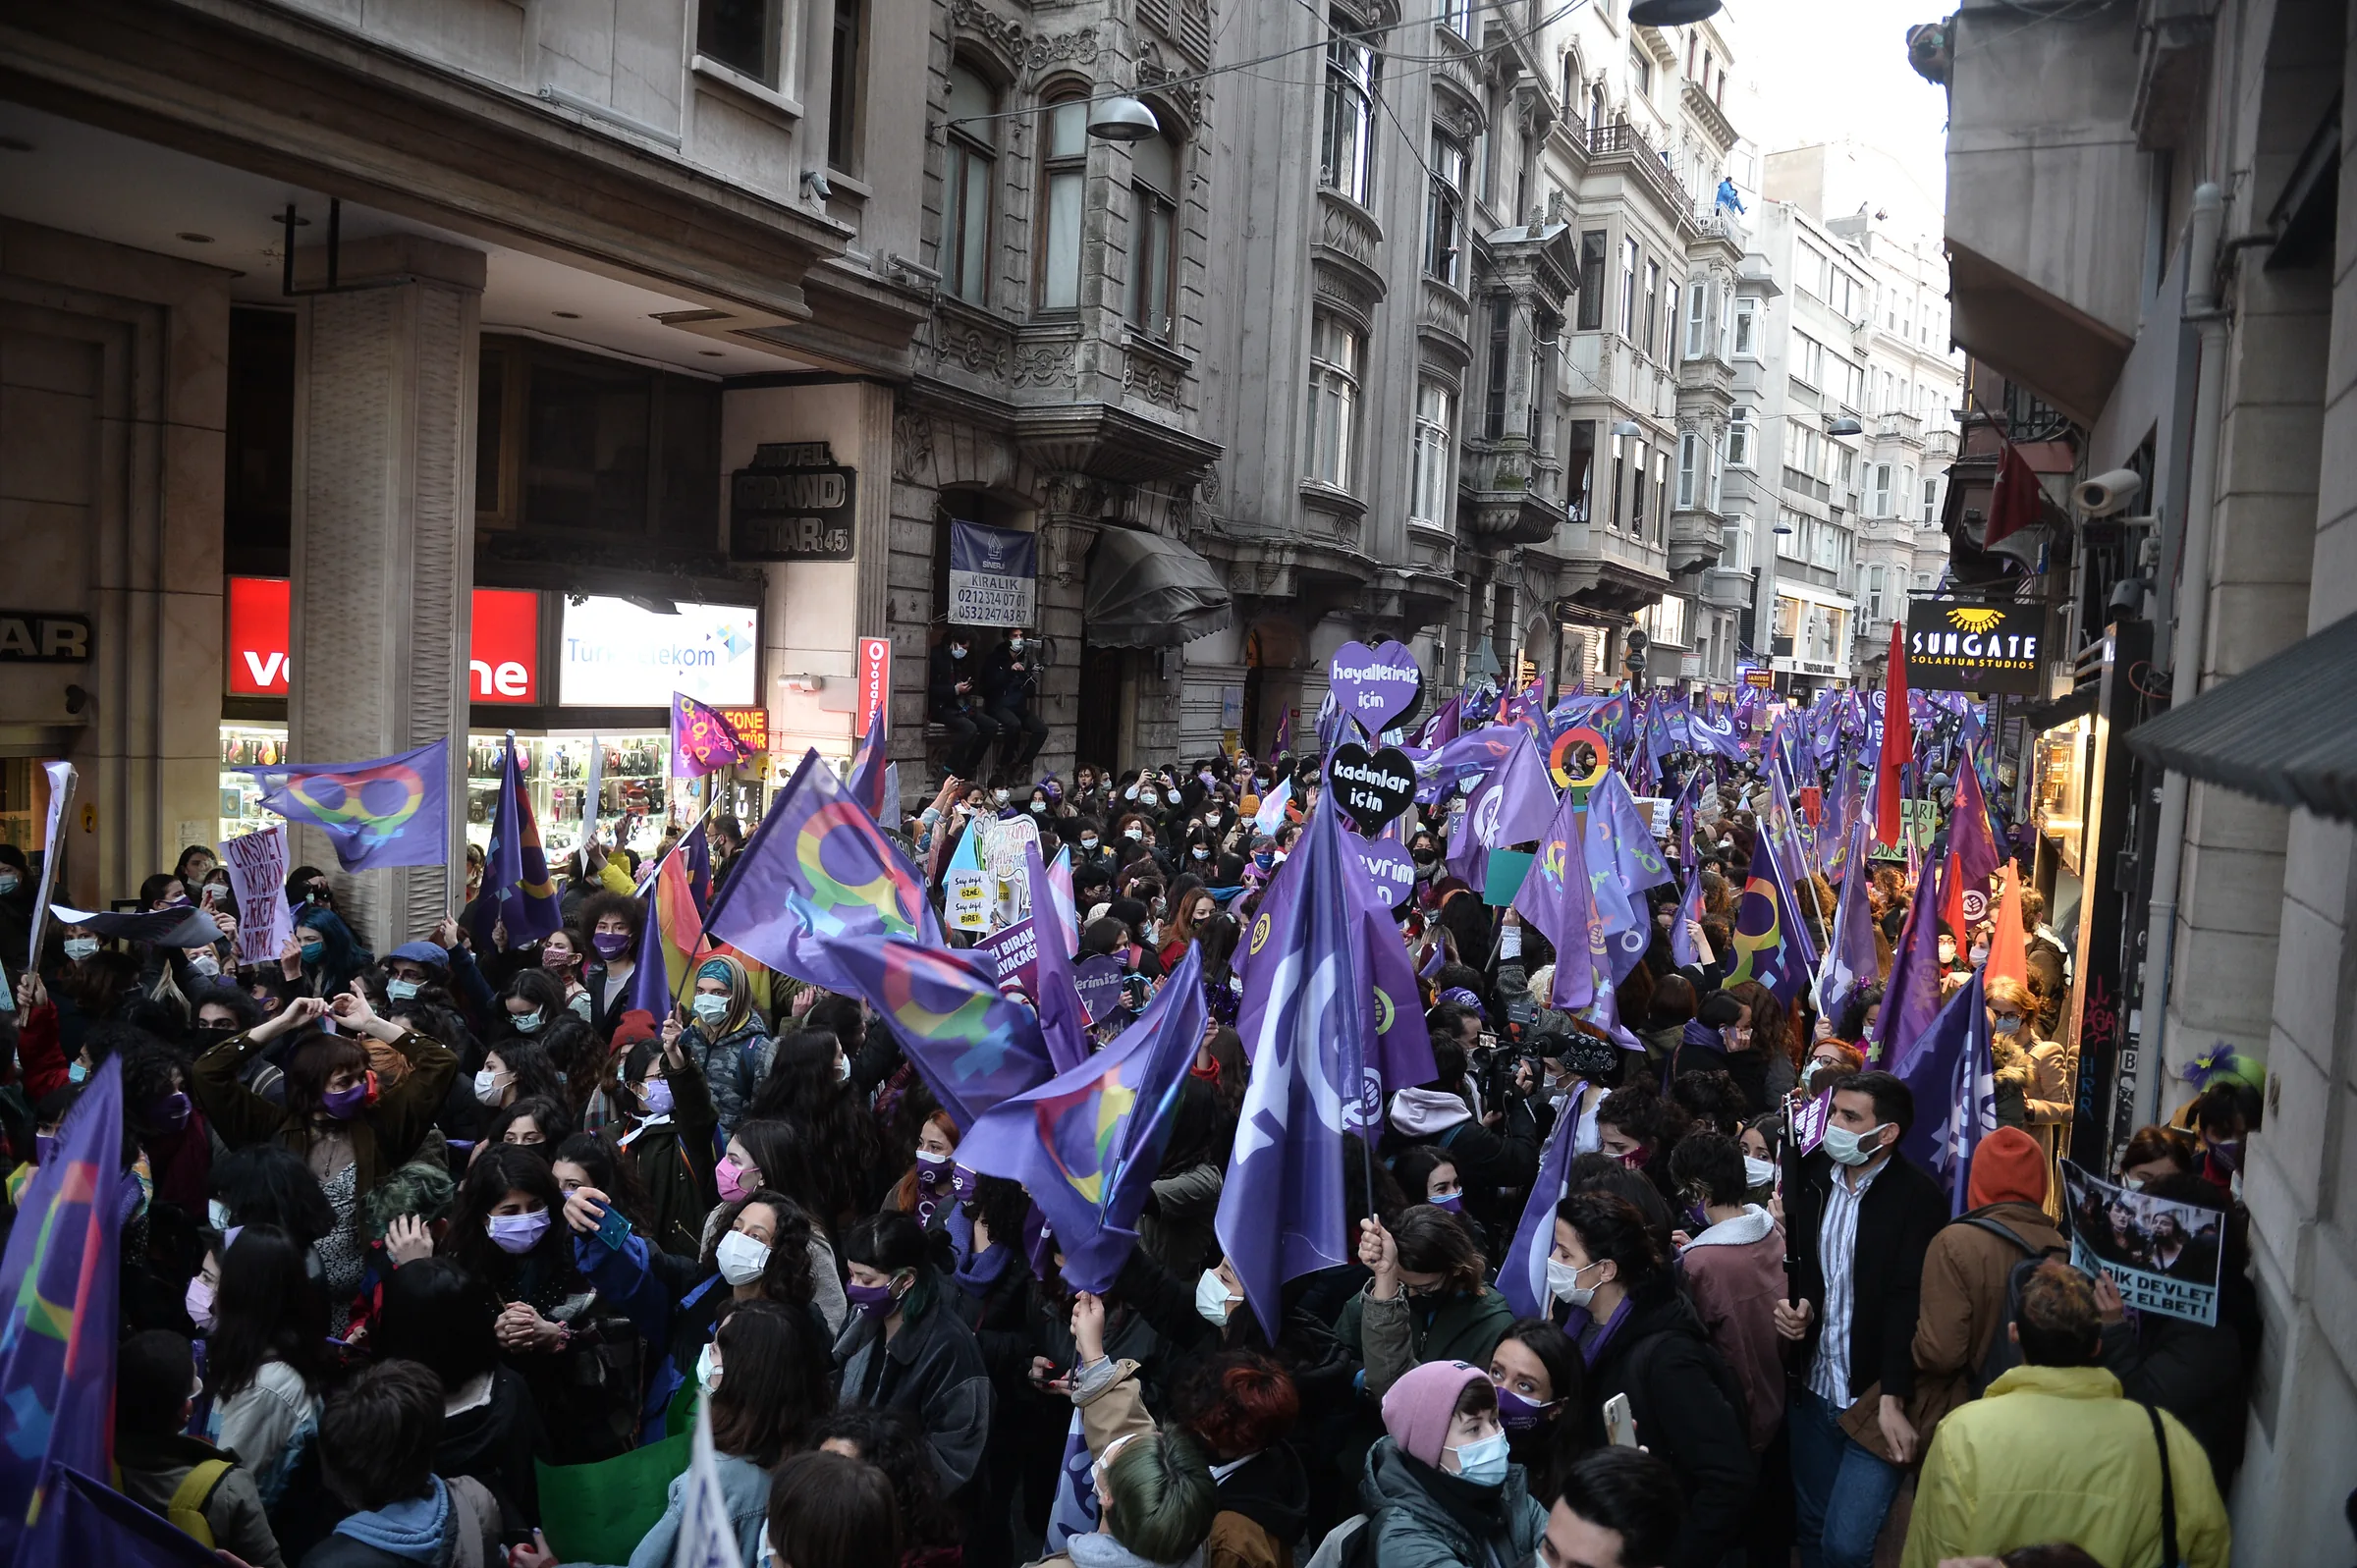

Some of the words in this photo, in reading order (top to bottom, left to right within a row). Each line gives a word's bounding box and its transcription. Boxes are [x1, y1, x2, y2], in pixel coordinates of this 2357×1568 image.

[736, 473, 846, 509] GRAND
[747, 517, 824, 552] STAR
[971, 574, 1018, 590] KİRALIK
[959, 589, 983, 604] 0212
[985, 591, 1002, 605] 324
[1004, 592, 1015, 606] 07
[959, 605, 983, 620] 0532
[985, 607, 1002, 621] 247
[1004, 609, 1014, 622] 43
[1912, 631, 2037, 659] SUNGATE
[1333, 660, 1419, 684] hayallerimiz
[1910, 655, 1975, 667] SOLARIUM
[1978, 659, 2035, 670] STUDIOS
[1358, 690, 1385, 709] için
[1334, 760, 1410, 793] kadınlar
[1349, 787, 1383, 812] için
[2137, 1277, 2216, 1305] DEVLET
[2137, 1291, 2207, 1320] ELBET!
